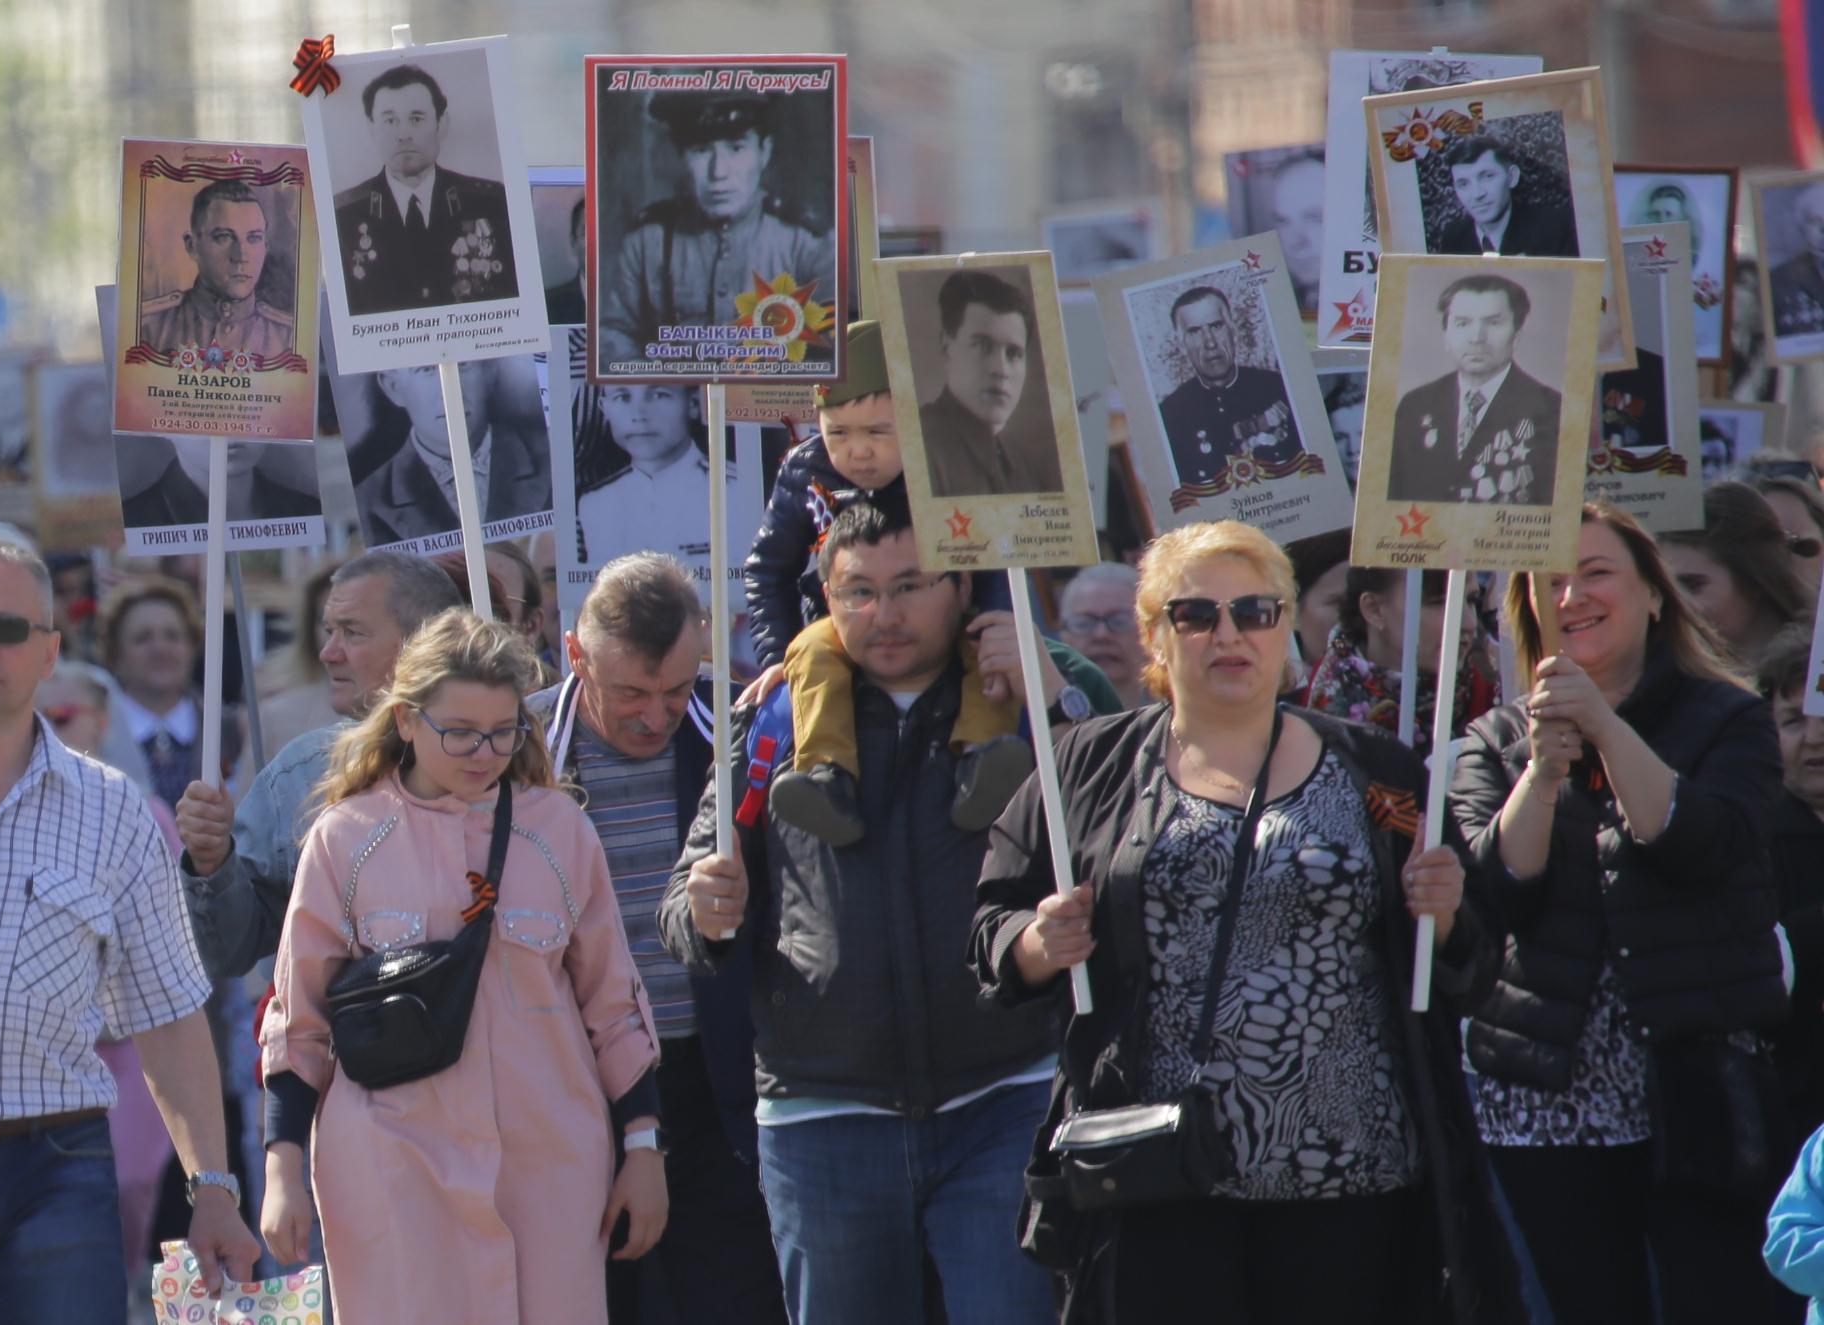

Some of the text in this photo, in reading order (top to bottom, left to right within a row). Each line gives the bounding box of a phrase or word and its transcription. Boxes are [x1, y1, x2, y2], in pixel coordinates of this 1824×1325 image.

[609, 70, 831, 94] Я Помню! Я Горжусь!
[1343, 250, 1378, 274] БУ
[352, 308, 521, 338] Буянов Иван Тихонович
[379, 326, 504, 348] старший прапорщик
[658, 326, 774, 341] БАЛЫКБАЕВ
[645, 342, 788, 360] Эбич (Ибрагим)
[609, 361, 663, 374] старший
[178, 373, 252, 390] НАЗАРОВ
[147, 386, 282, 404] Павел Николаевич
[1231, 491, 1274, 511] Зуйков
[1236, 494, 1311, 522] Дмитриевич
[1019, 505, 1069, 519] Лебедев
[1495, 510, 1552, 526] Яровой
[142, 529, 188, 545] ГРИПИЧ
[229, 522, 308, 540] ТИМОФЕЕВИЧ
[1390, 552, 1427, 564] ПОЛК
